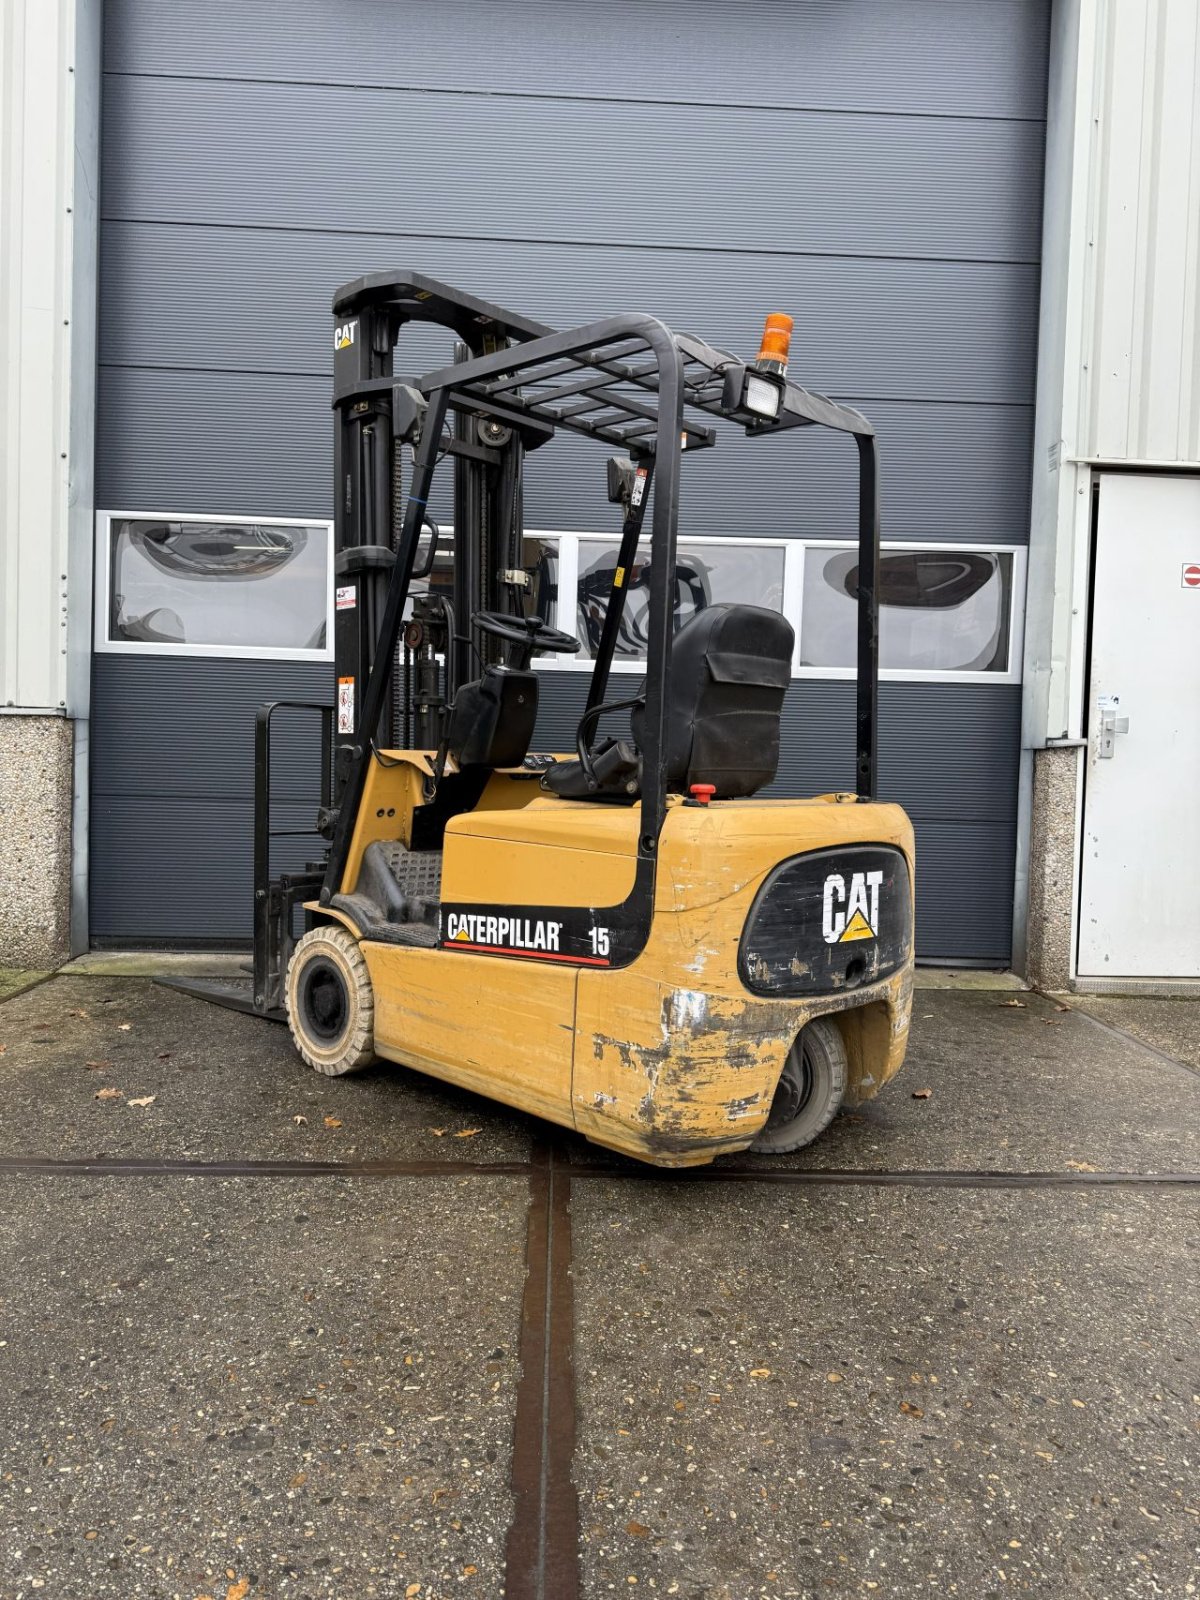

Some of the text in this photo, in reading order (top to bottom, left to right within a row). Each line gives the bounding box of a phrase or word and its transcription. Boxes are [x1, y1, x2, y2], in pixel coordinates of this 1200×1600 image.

[335, 321, 356, 350] CAT
[822, 870, 883, 943] CAT
[447, 913, 610, 956] CATERPILLAR 15
